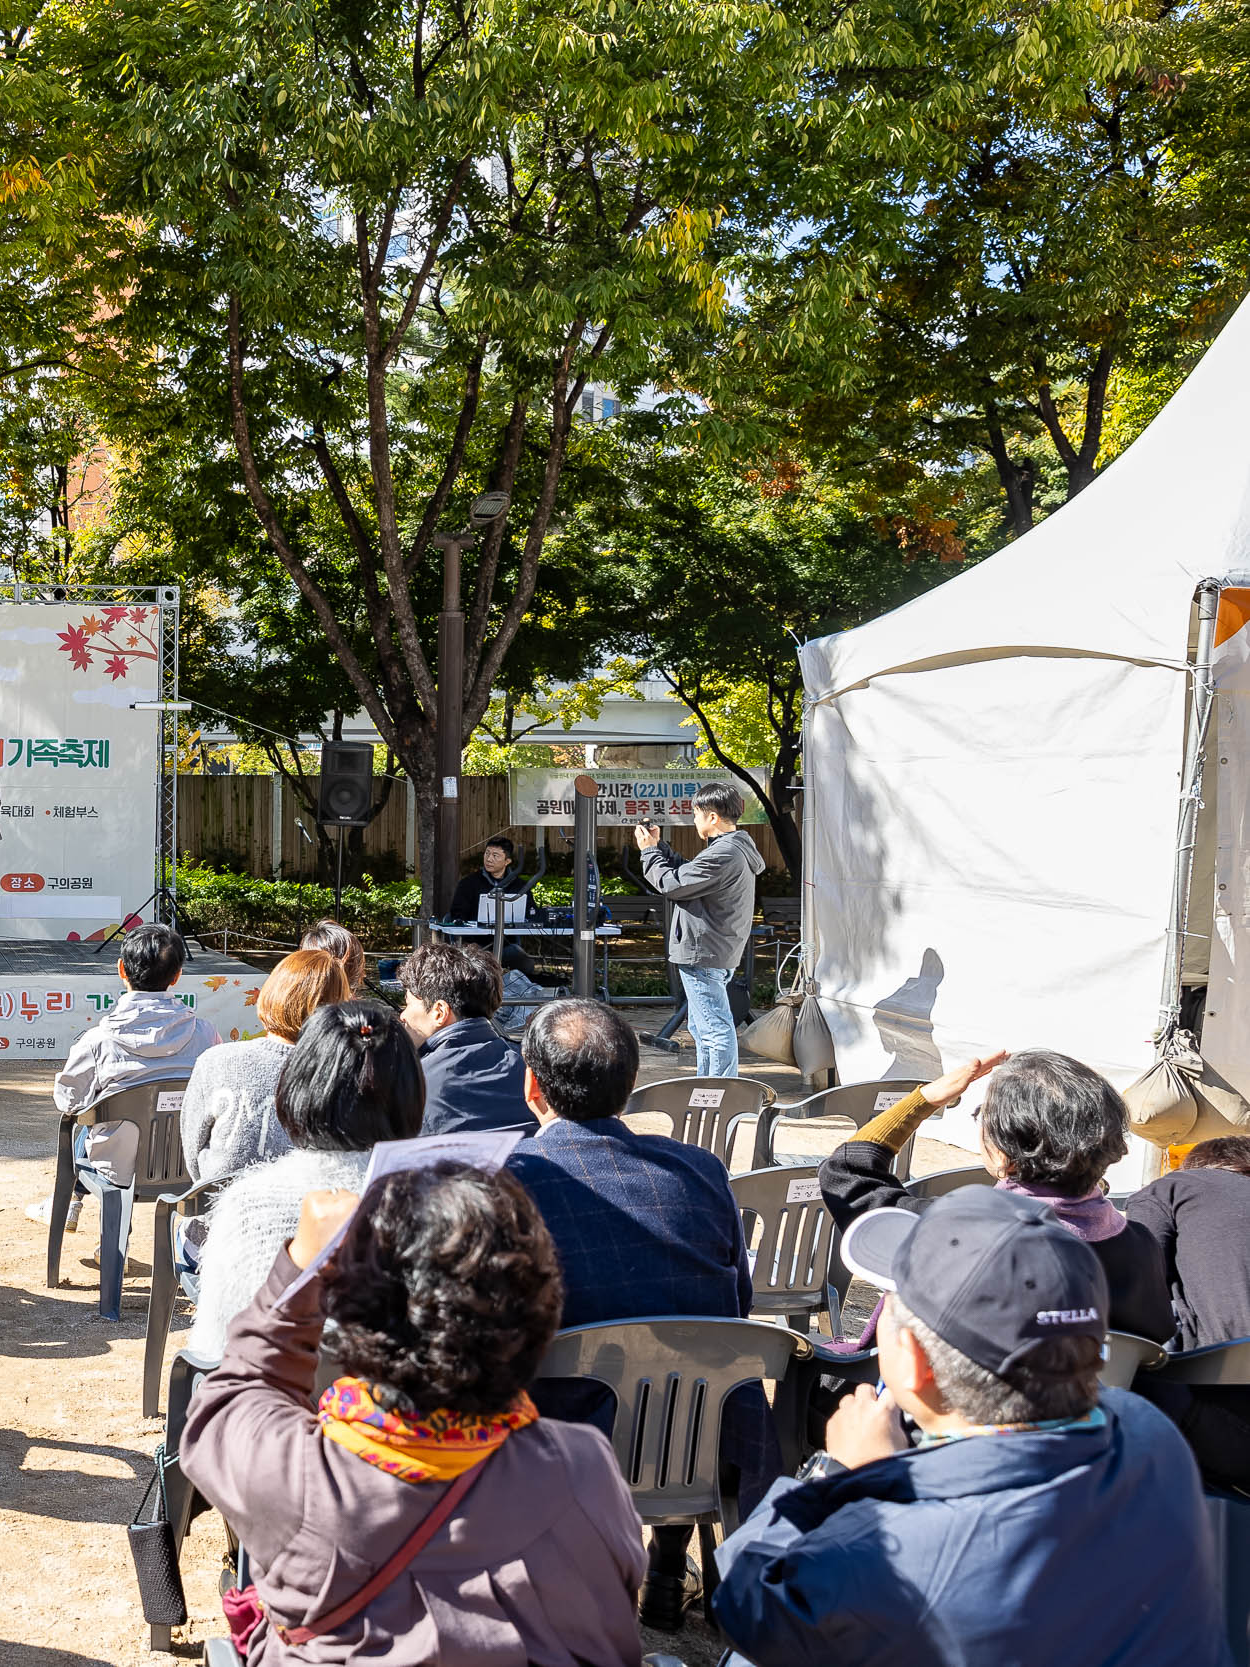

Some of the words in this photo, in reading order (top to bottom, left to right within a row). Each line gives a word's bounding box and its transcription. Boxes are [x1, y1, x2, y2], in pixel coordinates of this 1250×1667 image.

[7, 738, 110, 768] 가족축제
[53, 806, 99, 818] 체험부스
[536, 799, 575, 815] 공원이
[624, 800, 650, 816] 음주
[653, 799, 666, 816] 및
[47, 877, 93, 890] 구의공원
[15, 1038, 56, 1050] 구의공원
[1036, 1307, 1099, 1325] STELLA
